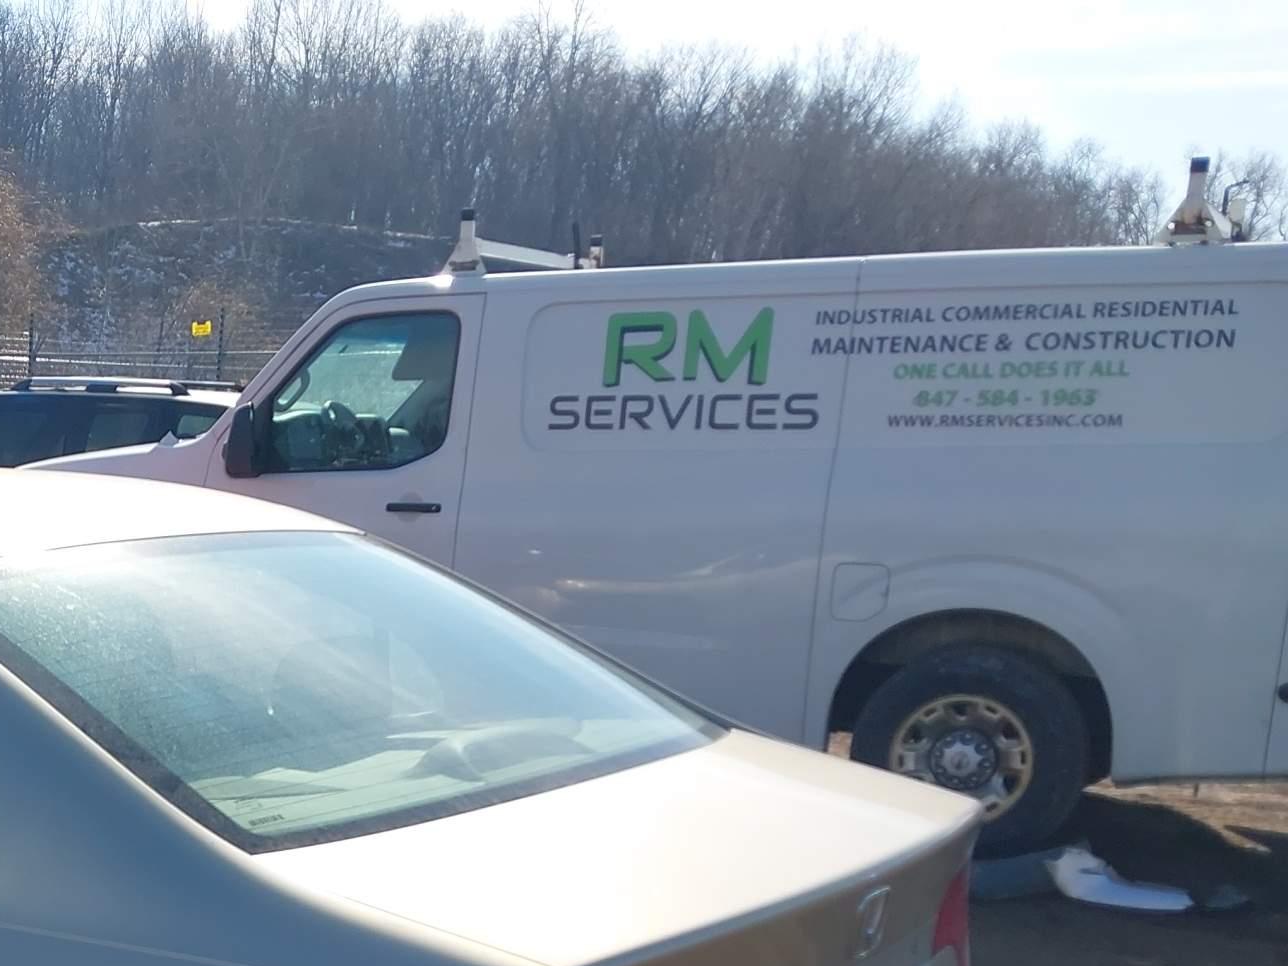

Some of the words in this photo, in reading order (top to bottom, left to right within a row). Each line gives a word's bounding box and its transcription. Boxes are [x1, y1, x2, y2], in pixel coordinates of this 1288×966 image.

[815, 307, 936, 326] INDUSTRIAL
[941, 303, 1087, 322] COMMERCIAL
[1092, 299, 1240, 319] RESIDENTIAL
[603, 306, 775, 387] RM
[810, 334, 989, 355] MAINTENANCE
[994, 333, 1013, 352] &
[1024, 328, 1237, 351] CONSTRUCTION
[893, 362, 937, 380] ONE
[942, 361, 993, 379] CALL
[999, 360, 1059, 379] DOES
[1064, 360, 1085, 379] IT
[1089, 359, 1131, 378] ALL
[548, 393, 820, 431] SERVICES
[912, 389, 959, 408] 847
[887, 413, 1124, 428] WWW.RMSERVICESINC.COM
